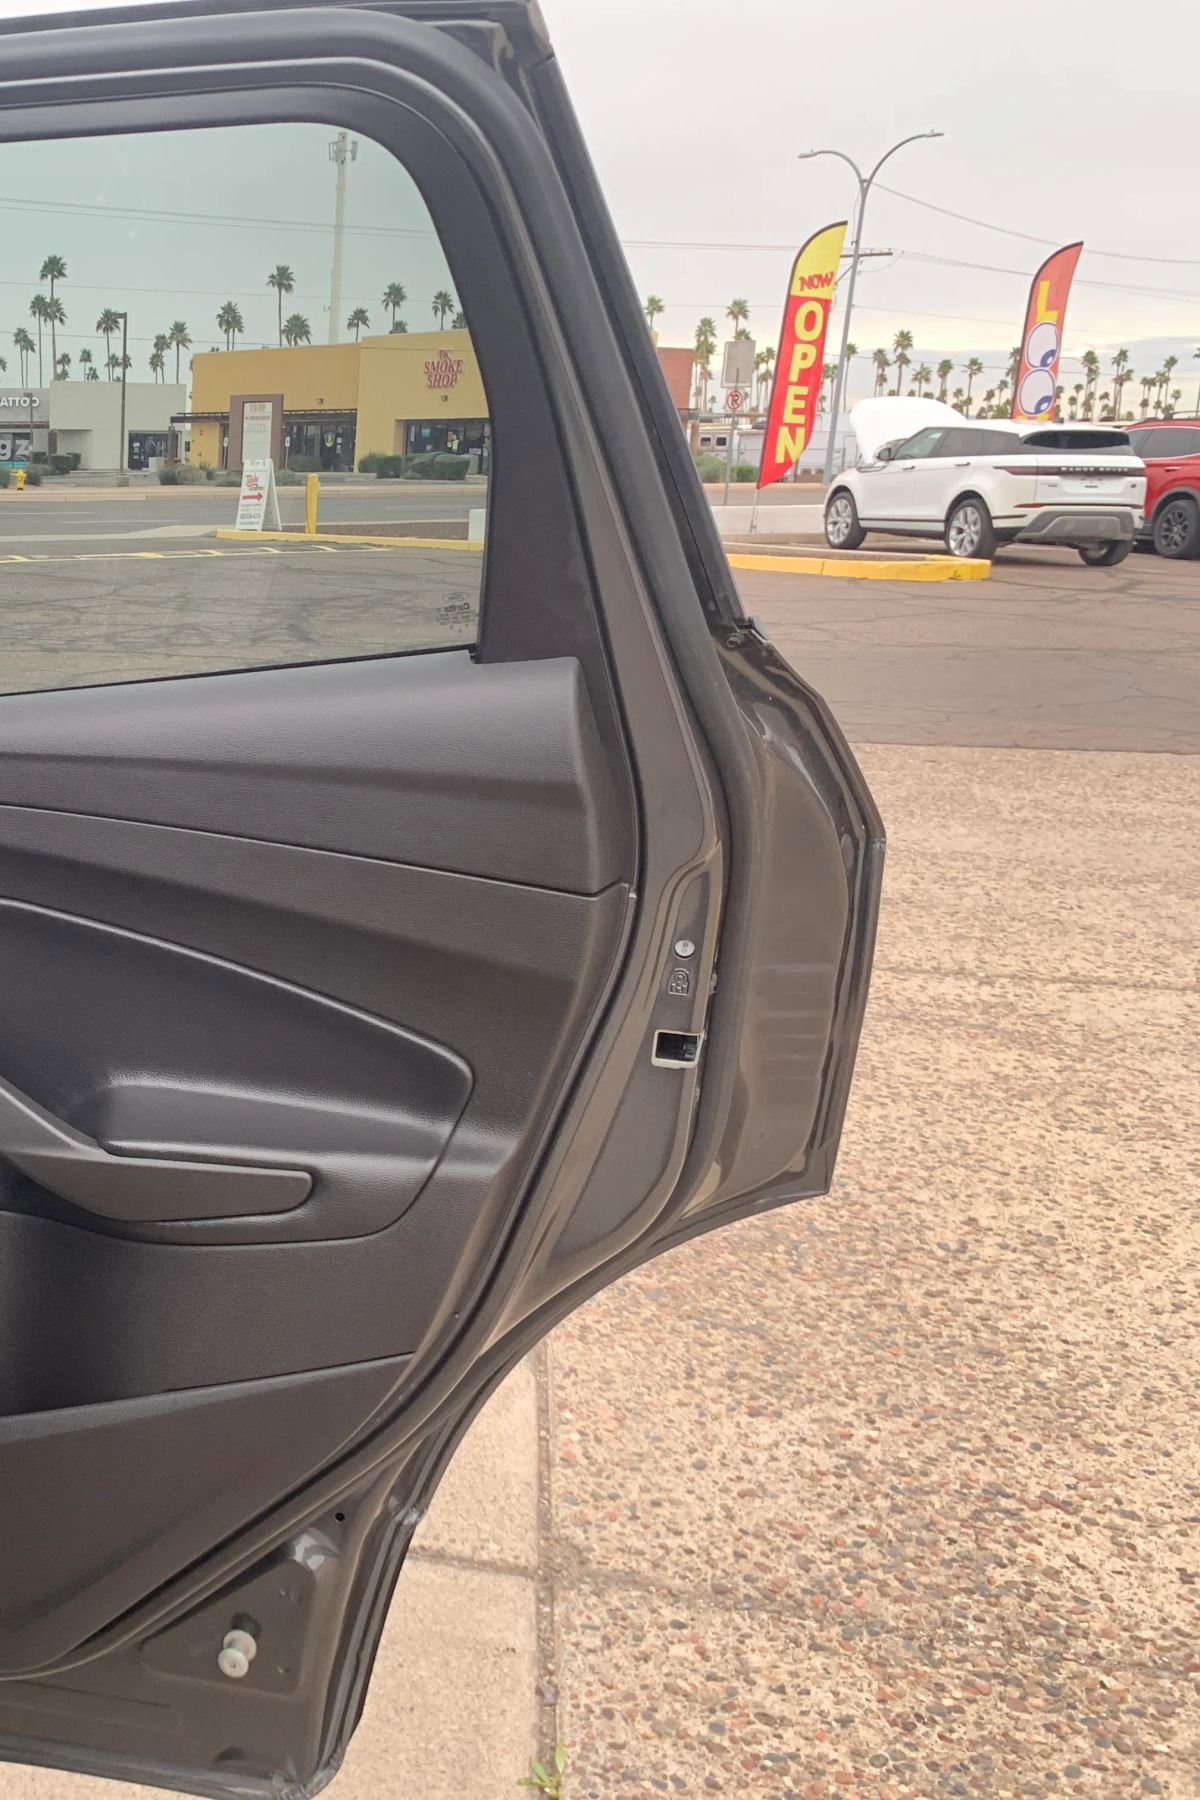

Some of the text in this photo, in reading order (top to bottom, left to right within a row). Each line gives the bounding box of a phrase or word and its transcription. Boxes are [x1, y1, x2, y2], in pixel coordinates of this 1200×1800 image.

[799, 271, 835, 291] NOW
[424, 360, 464, 374] SMOKE
[426, 374, 458, 388] SHOP
[775, 301, 824, 463] OPEN
